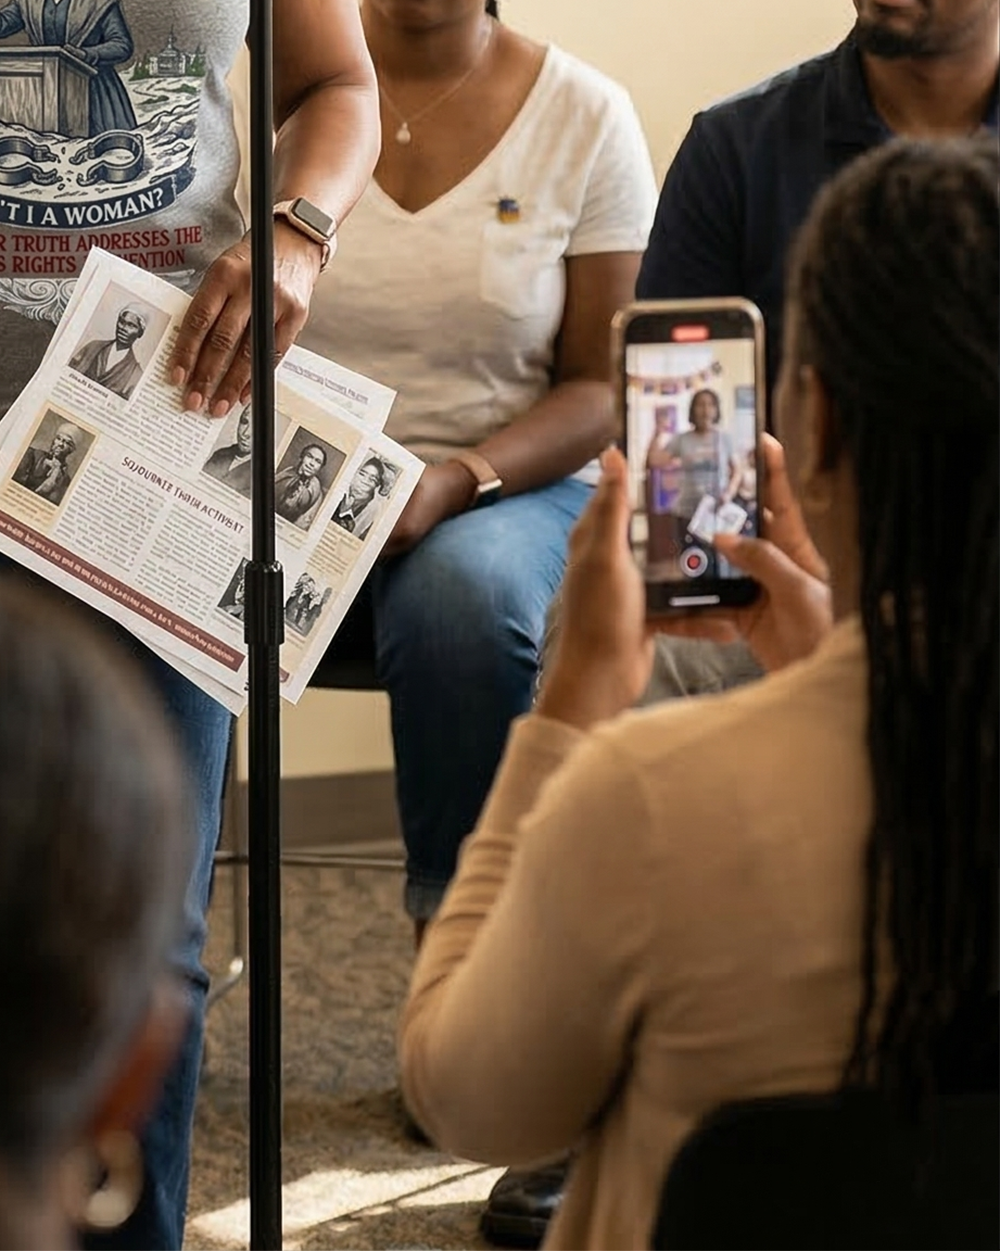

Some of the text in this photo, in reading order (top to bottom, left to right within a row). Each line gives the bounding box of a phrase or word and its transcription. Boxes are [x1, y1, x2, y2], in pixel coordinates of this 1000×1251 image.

[26, 205, 34, 224] I
[40, 206, 59, 226] A
[64, 188, 164, 225] WOMAN?
[11, 234, 71, 253] TRUTH
[75, 229, 170, 253] ADDRESSES
[174, 226, 203, 245] THE
[11, 255, 77, 274] RIGHTS
[83, 249, 186, 270] ENTION
